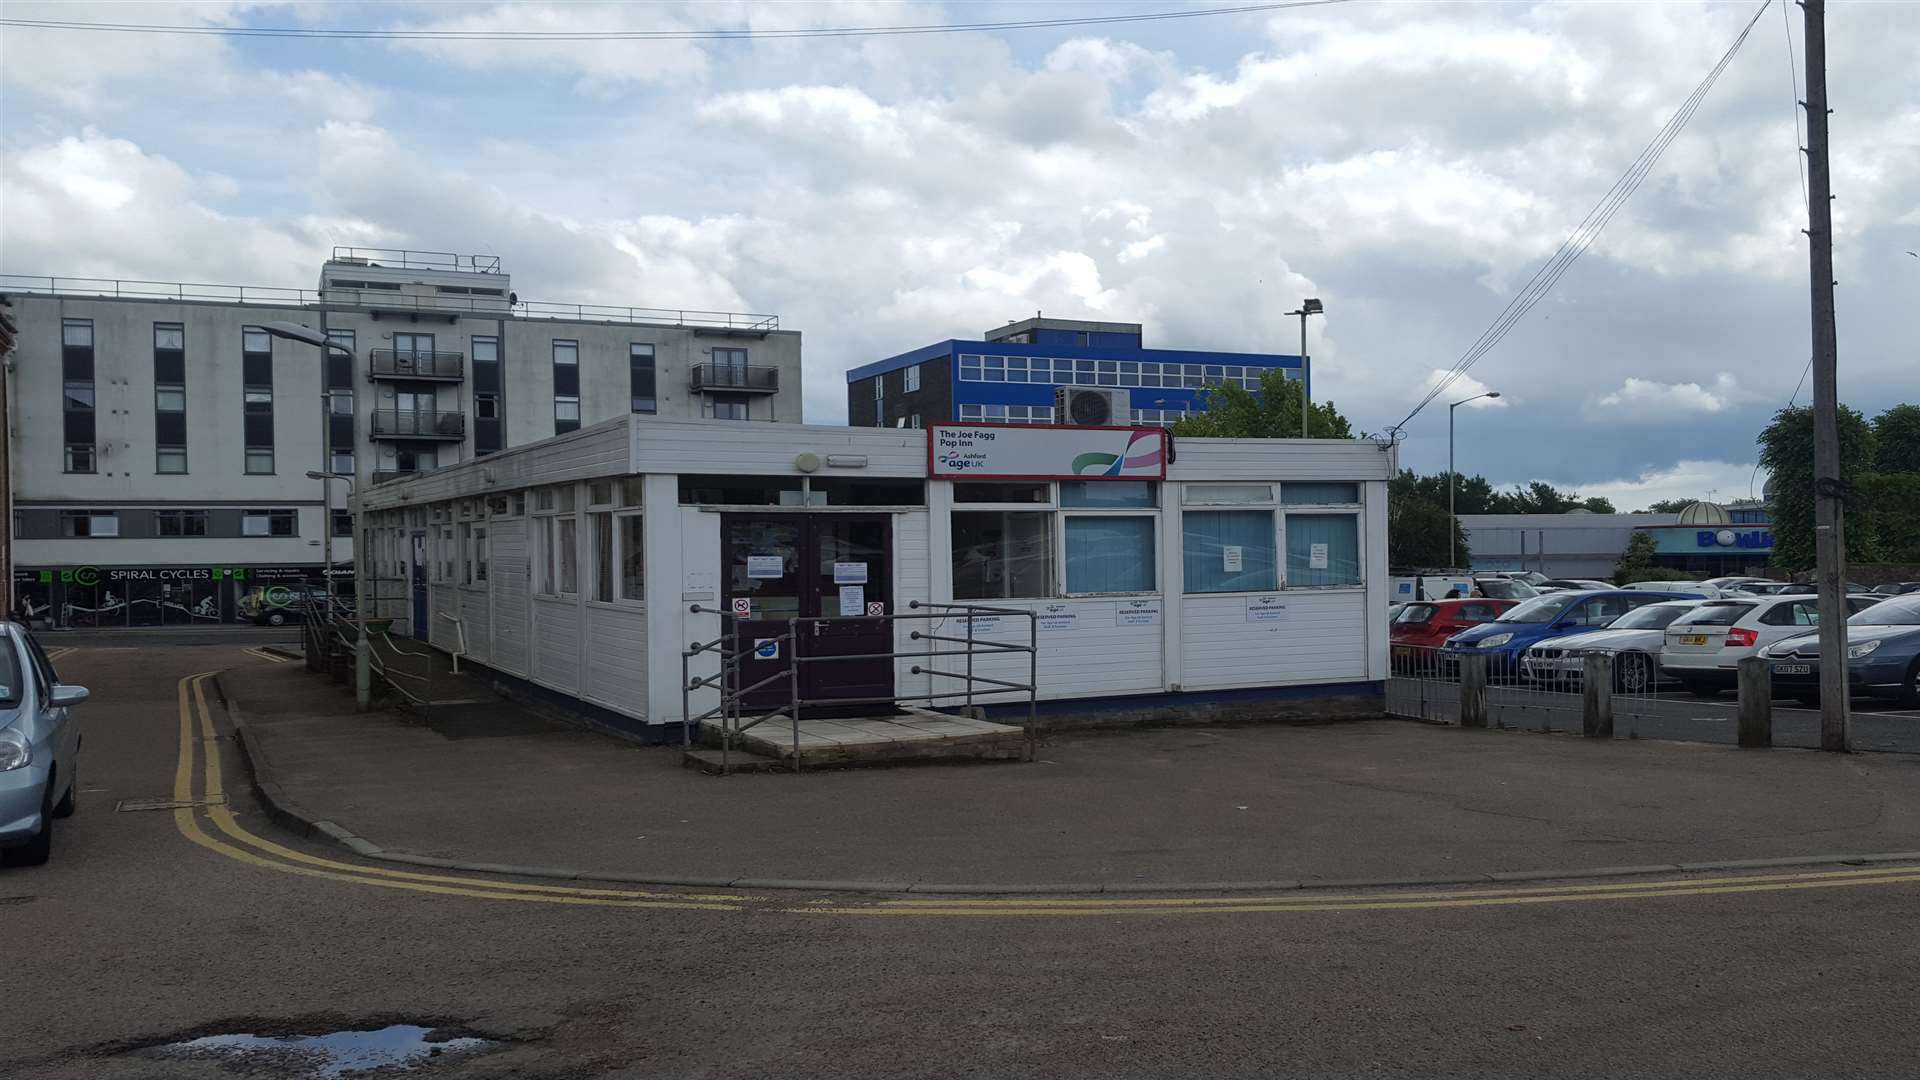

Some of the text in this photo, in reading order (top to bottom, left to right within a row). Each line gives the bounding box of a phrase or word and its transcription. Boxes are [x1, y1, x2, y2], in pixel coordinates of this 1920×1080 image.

[940, 430, 996, 441] The Joe Fagg
[940, 439, 973, 448] Pop Inn
[948, 460, 970, 470] age
[110, 569, 209, 580] SPIRAL CYCLES
